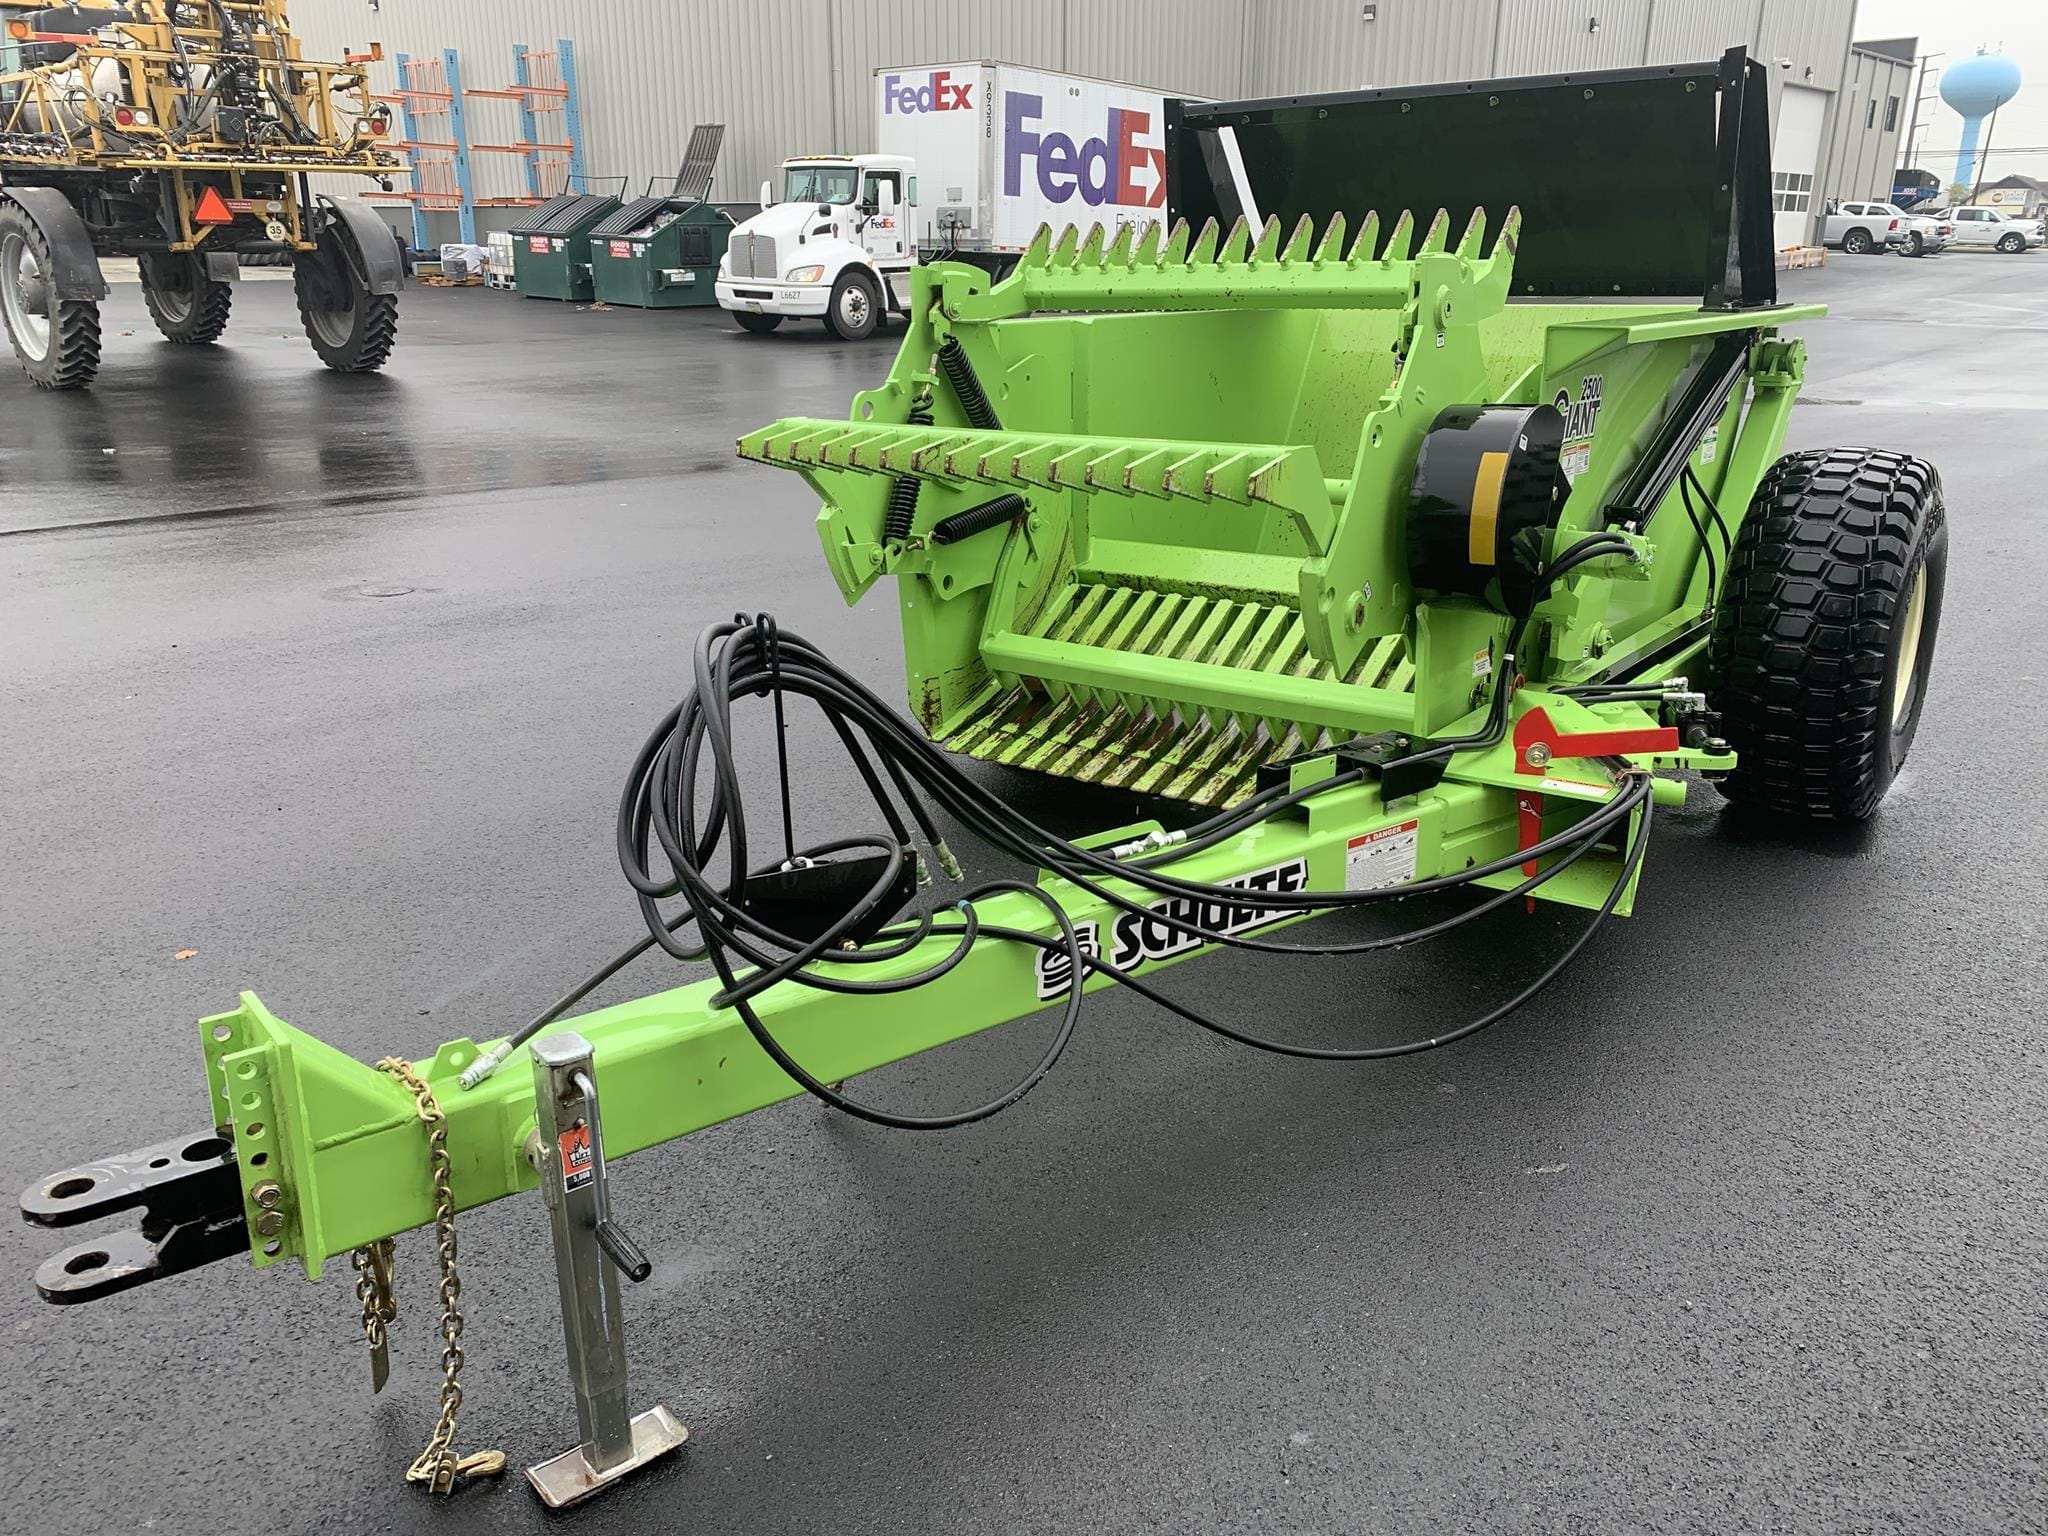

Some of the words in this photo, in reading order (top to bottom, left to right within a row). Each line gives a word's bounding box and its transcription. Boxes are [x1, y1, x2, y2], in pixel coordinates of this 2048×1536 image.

[885, 71, 973, 114] FedEx
[270, 226, 281, 234] 35
[871, 218, 895, 229] FedEx
[781, 291, 800, 299] L6627
[1581, 376, 1602, 400] 2500
[1373, 826, 1402, 841] DANGER
